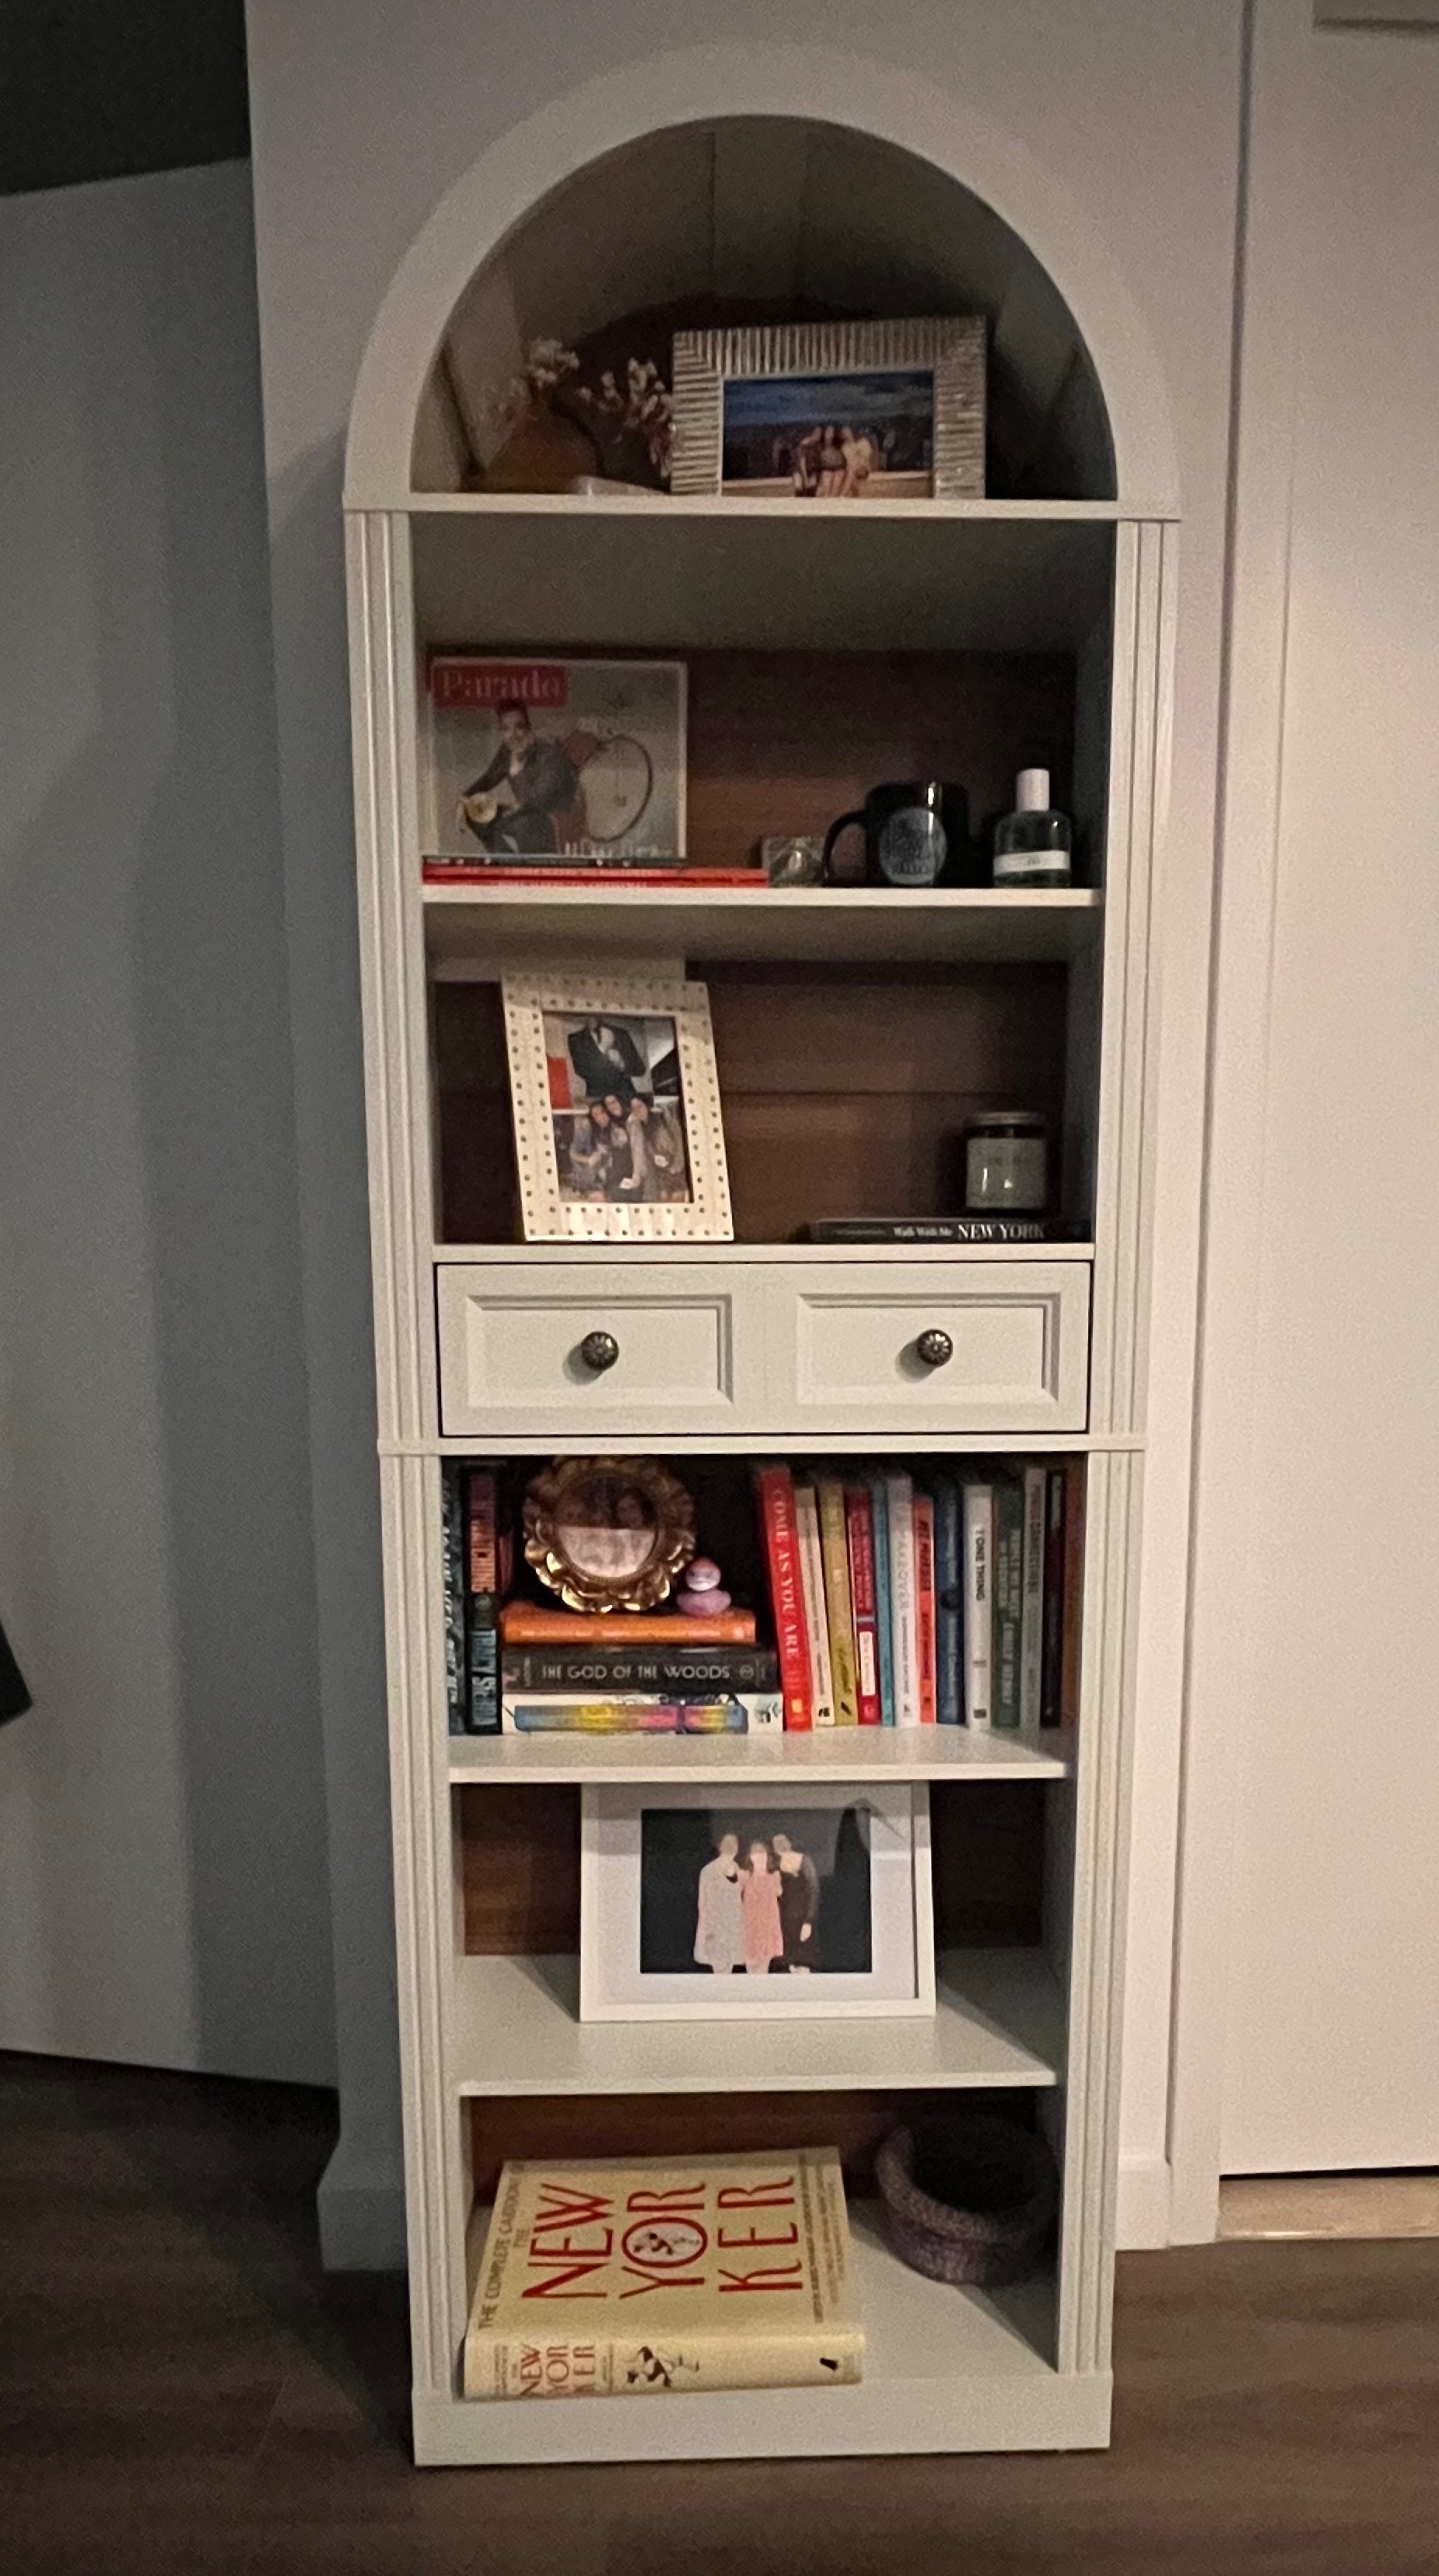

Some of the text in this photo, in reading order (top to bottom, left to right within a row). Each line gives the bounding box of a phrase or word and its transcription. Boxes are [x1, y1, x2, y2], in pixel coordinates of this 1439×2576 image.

[958, 1224, 993, 1239] NEW
[1000, 1224, 1044, 1239] YORK
[772, 1487, 789, 1543] COME
[778, 1551, 790, 1572] AS
[975, 1537, 986, 1561] ONE
[780, 1577, 796, 1616] YOU
[975, 1564, 986, 1601] THING
[784, 1624, 799, 1656] ARE
[542, 1665, 561, 1679] THE
[568, 1665, 607, 1679] GOD
[613, 1665, 631, 1679] OF
[638, 1665, 657, 1679] THE
[663, 1665, 730, 1680] WOODS
[522, 2183, 614, 2298] NEW
[619, 2182, 707, 2299] YOR
[717, 2176, 803, 2292] KER
[478, 2304, 498, 2330] THE
[520, 2343, 543, 2396] NEW
